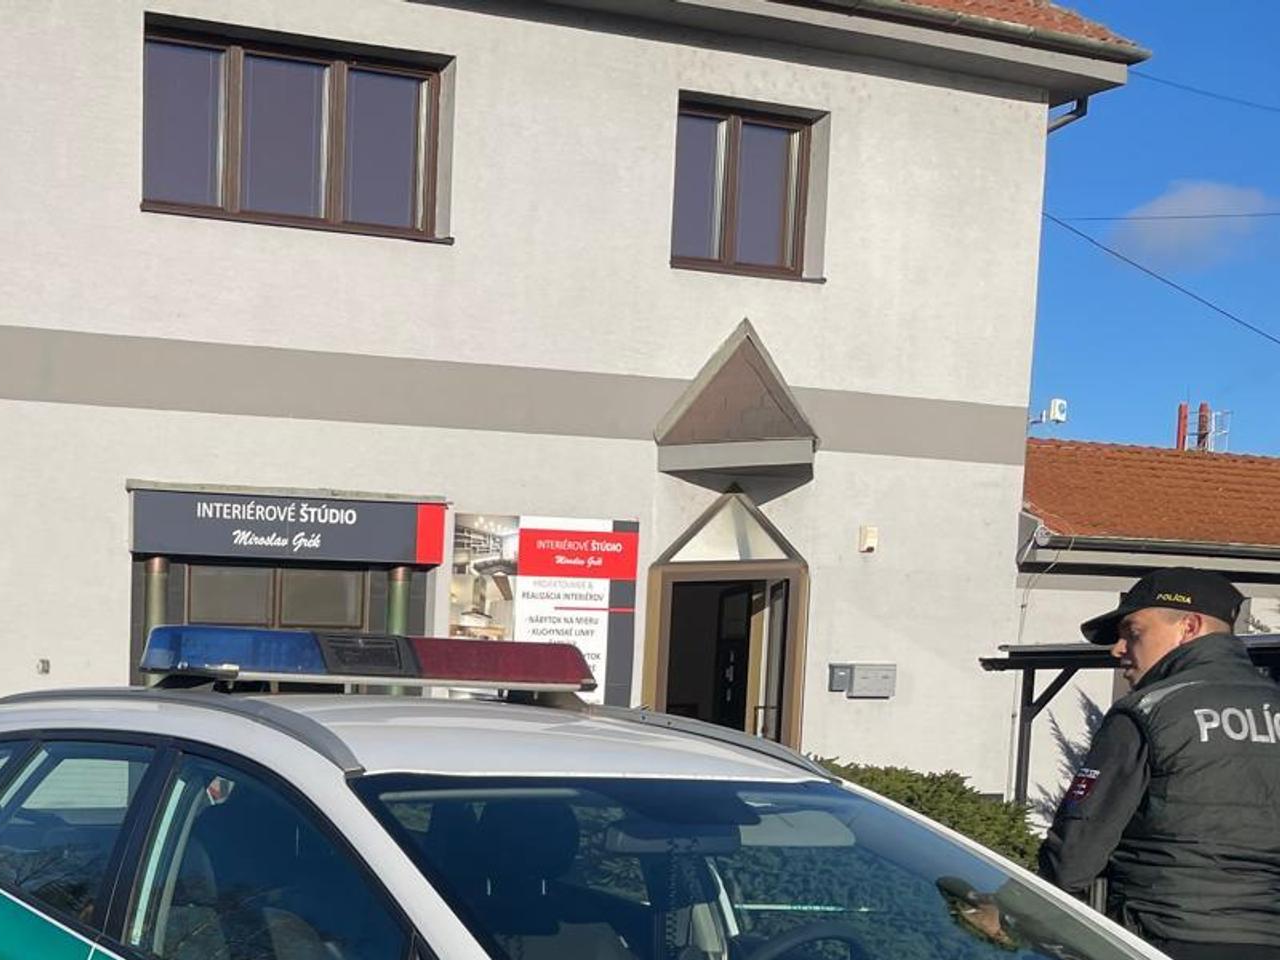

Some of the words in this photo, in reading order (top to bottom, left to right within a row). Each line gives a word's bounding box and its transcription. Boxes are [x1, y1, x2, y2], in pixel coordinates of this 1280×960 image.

[196, 501, 296, 522] INTERIÉROVÉ
[299, 503, 357, 525] ŠTÚDIO
[231, 529, 289, 547] Miroslav
[590, 538, 623, 553] ŠTÚDIO
[1156, 593, 1192, 605] POLÍCIA
[1193, 703, 1280, 743] POLÍ
